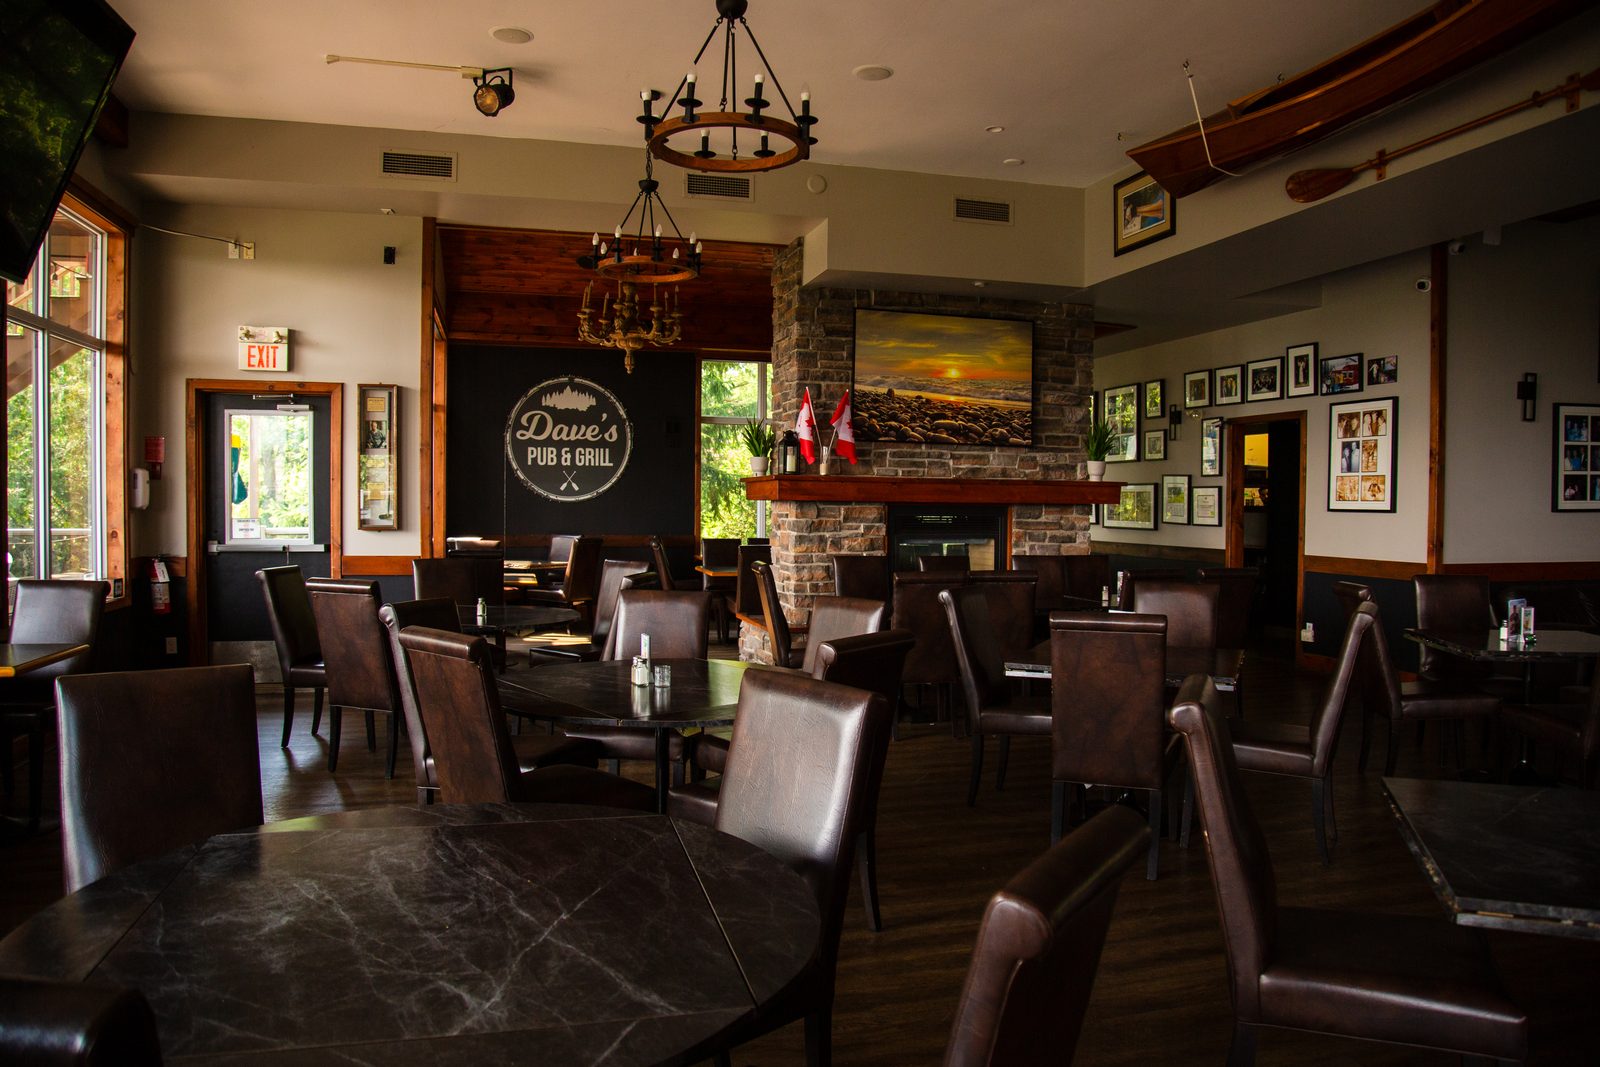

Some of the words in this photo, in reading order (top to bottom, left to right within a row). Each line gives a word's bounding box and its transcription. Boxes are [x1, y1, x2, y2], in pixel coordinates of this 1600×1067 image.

[247, 345, 279, 368] EXIT
[515, 410, 618, 442] Dave's
[527, 446, 557, 466] PUB
[561, 447, 572, 466] &
[575, 447, 614, 467] GRILL
